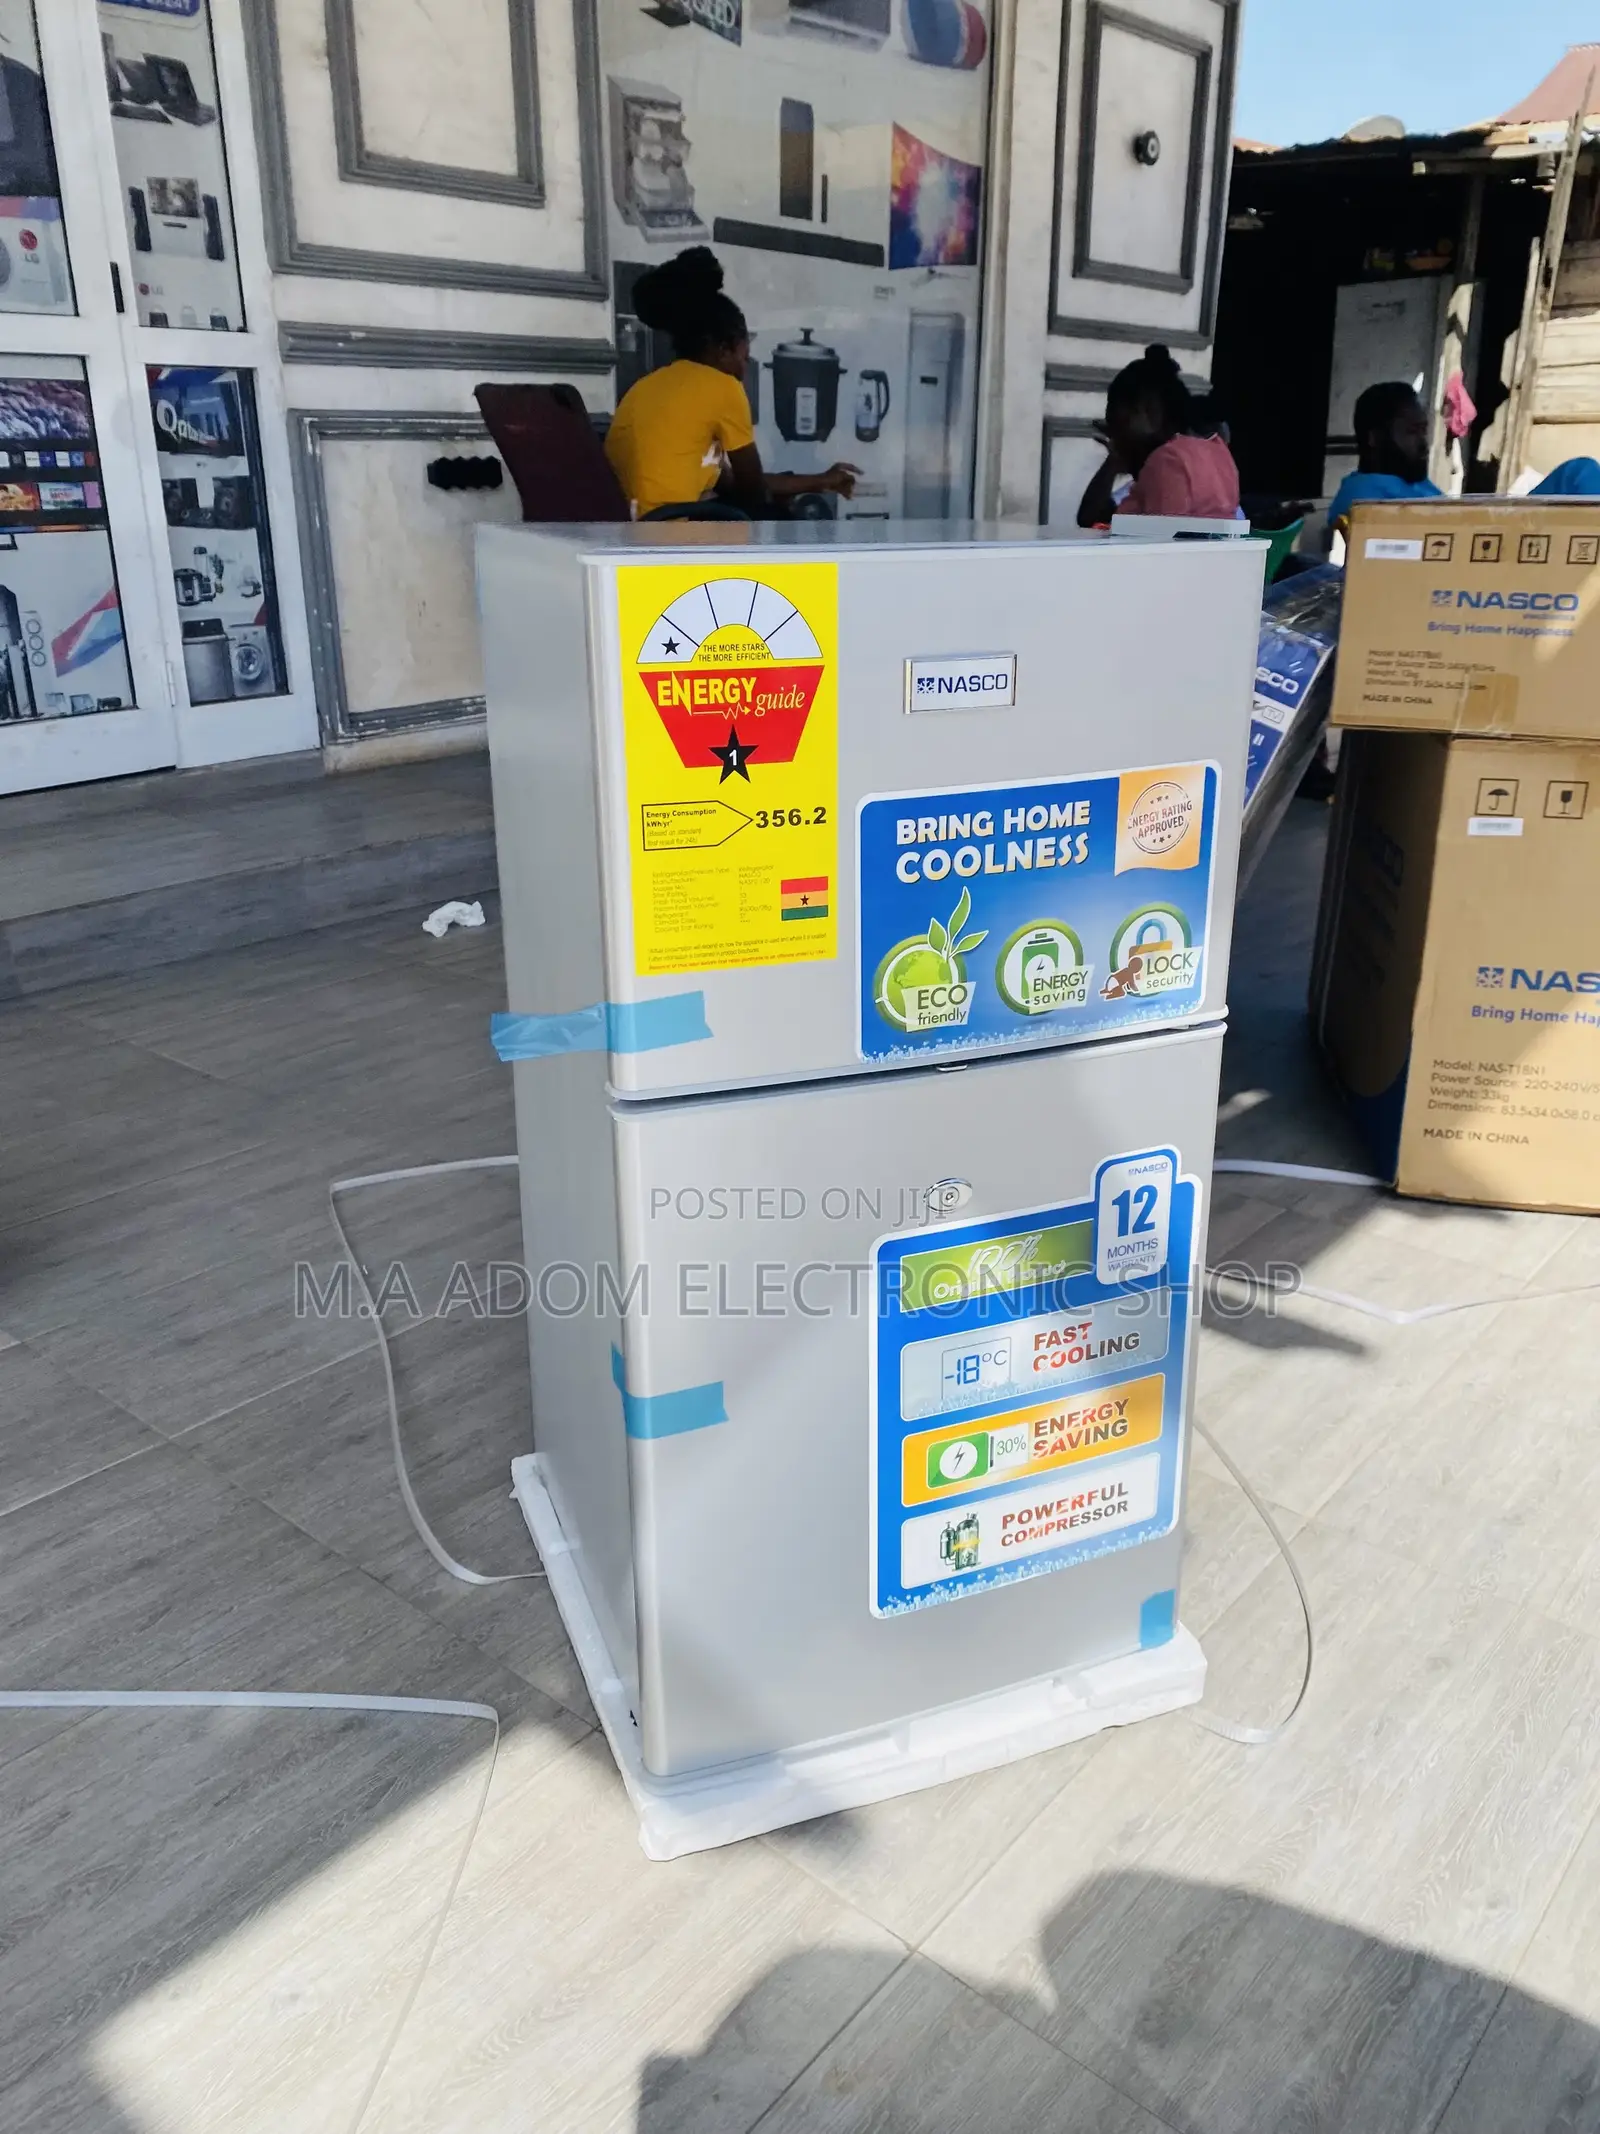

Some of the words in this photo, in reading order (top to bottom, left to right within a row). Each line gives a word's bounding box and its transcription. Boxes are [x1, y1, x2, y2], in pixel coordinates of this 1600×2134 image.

[25, 253, 40, 264] LG
[151, 286, 164, 296] LG
[1456, 590, 1579, 611] NASCO
[1428, 621, 1461, 635] Bring
[1465, 623, 1502, 634] Home
[1507, 625, 1574, 639] Happiness
[720, 644, 739, 652] MORE
[742, 643, 764, 651] STARS
[698, 654, 711, 662] THE
[938, 674, 1008, 694] NASCO
[657, 671, 758, 717] ENERGY
[754, 684, 805, 717] guide
[1363, 694, 1390, 702] MADE
[1403, 696, 1433, 704] CHINA
[729, 750, 738, 766] 1
[672, 809, 717, 817] Consumption
[755, 806, 828, 829] 356.2
[1127, 811, 1160, 830] ENERGY
[1162, 800, 1193, 819] RATING
[896, 810, 995, 846] BRING
[1003, 800, 1091, 835] HOME
[1138, 815, 1185, 839] APPROVED
[896, 832, 1090, 884] COOLNESS
[1146, 952, 1194, 976] LOCK
[1032, 970, 1088, 992] ENERGY
[1146, 972, 1194, 990] security
[917, 984, 968, 1010] ECO
[1033, 987, 1086, 1006] saving
[917, 1007, 968, 1026] friendly
[1471, 1005, 1515, 1024] Bring
[1520, 1008, 1570, 1023] Home
[1432, 1058, 1474, 1071] Model:
[1431, 1072, 1470, 1084] Power
[1430, 1086, 1478, 1100] Weight:
[1427, 1099, 1496, 1114] Dimension:
[1422, 1128, 1464, 1140] MADE
[1468, 1130, 1482, 1141] IN
[1486, 1132, 1530, 1146] CHINA
[1134, 1162, 1168, 1176] NASCO
[1111, 1184, 1158, 1238] 12
[1107, 1238, 1159, 1260] MONTHS
[1108, 1254, 1157, 1272] WARRANTY
[1033, 1322, 1093, 1352] FAST
[1032, 1332, 1141, 1374] COOLING
[996, 1435, 1028, 1456] 30%
[1034, 1396, 1130, 1439] ENERGY
[1032, 1418, 1129, 1459] SAVING
[1002, 1482, 1130, 1530] POWERFUL
[1000, 1500, 1129, 1548] COMPRESSOR
